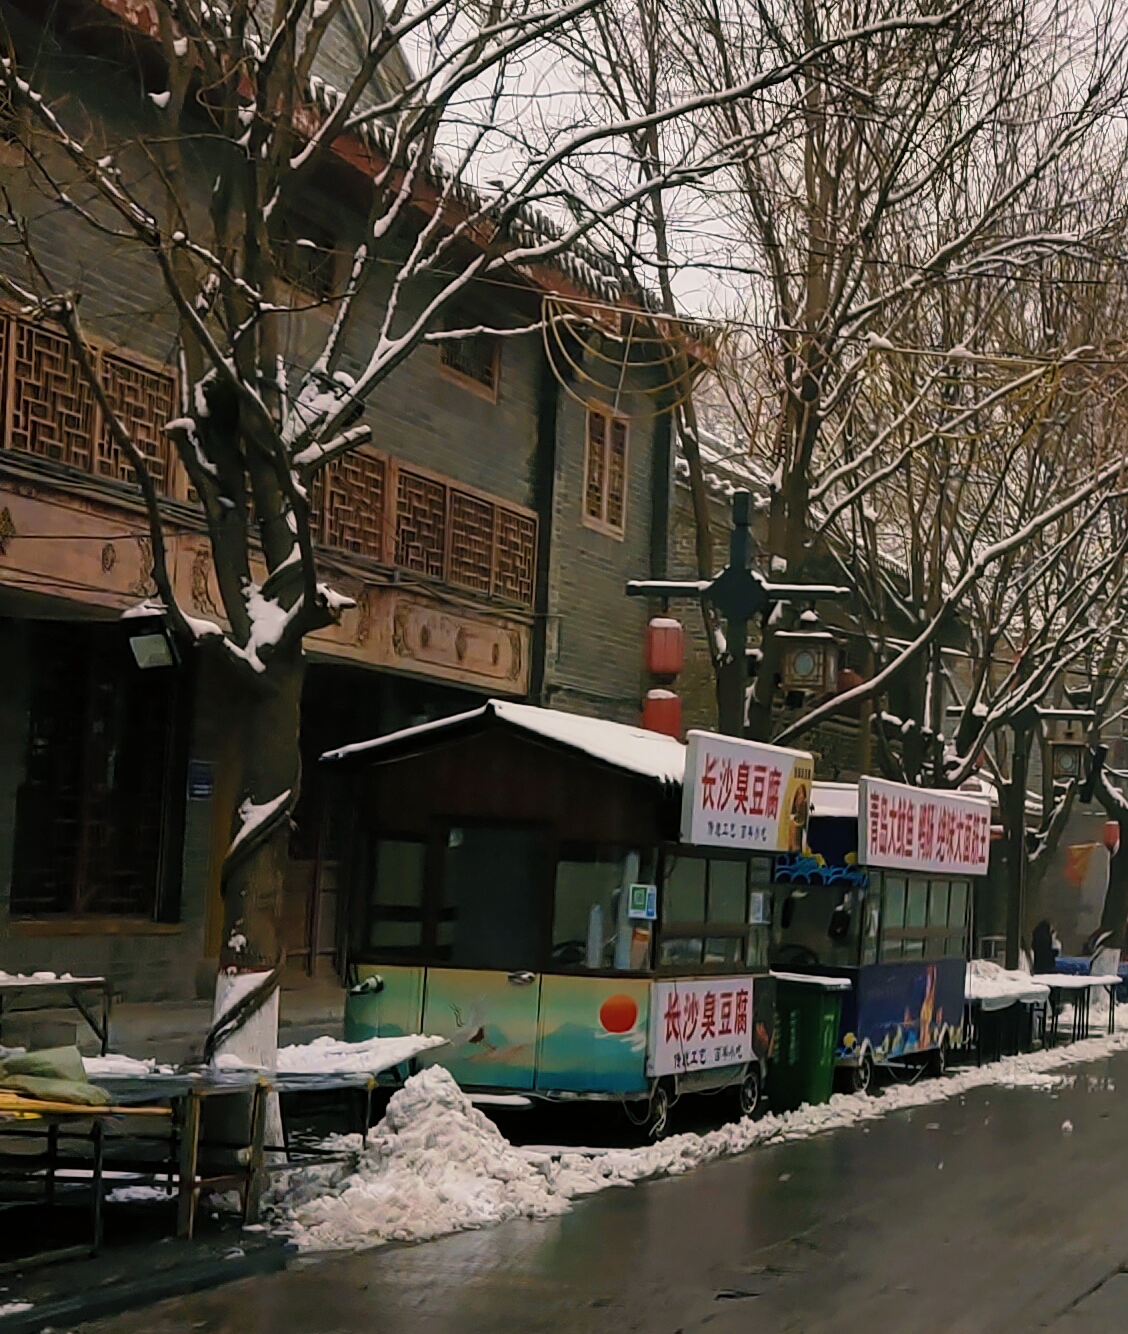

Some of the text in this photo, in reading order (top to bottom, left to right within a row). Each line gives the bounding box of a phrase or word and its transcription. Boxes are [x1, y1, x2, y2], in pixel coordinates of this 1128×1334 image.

[702, 752, 782, 821] 长沙臭豆腐
[869, 789, 913, 857] 青岛大鱿鱼
[664, 988, 748, 1044] 长沙臭豆腐
